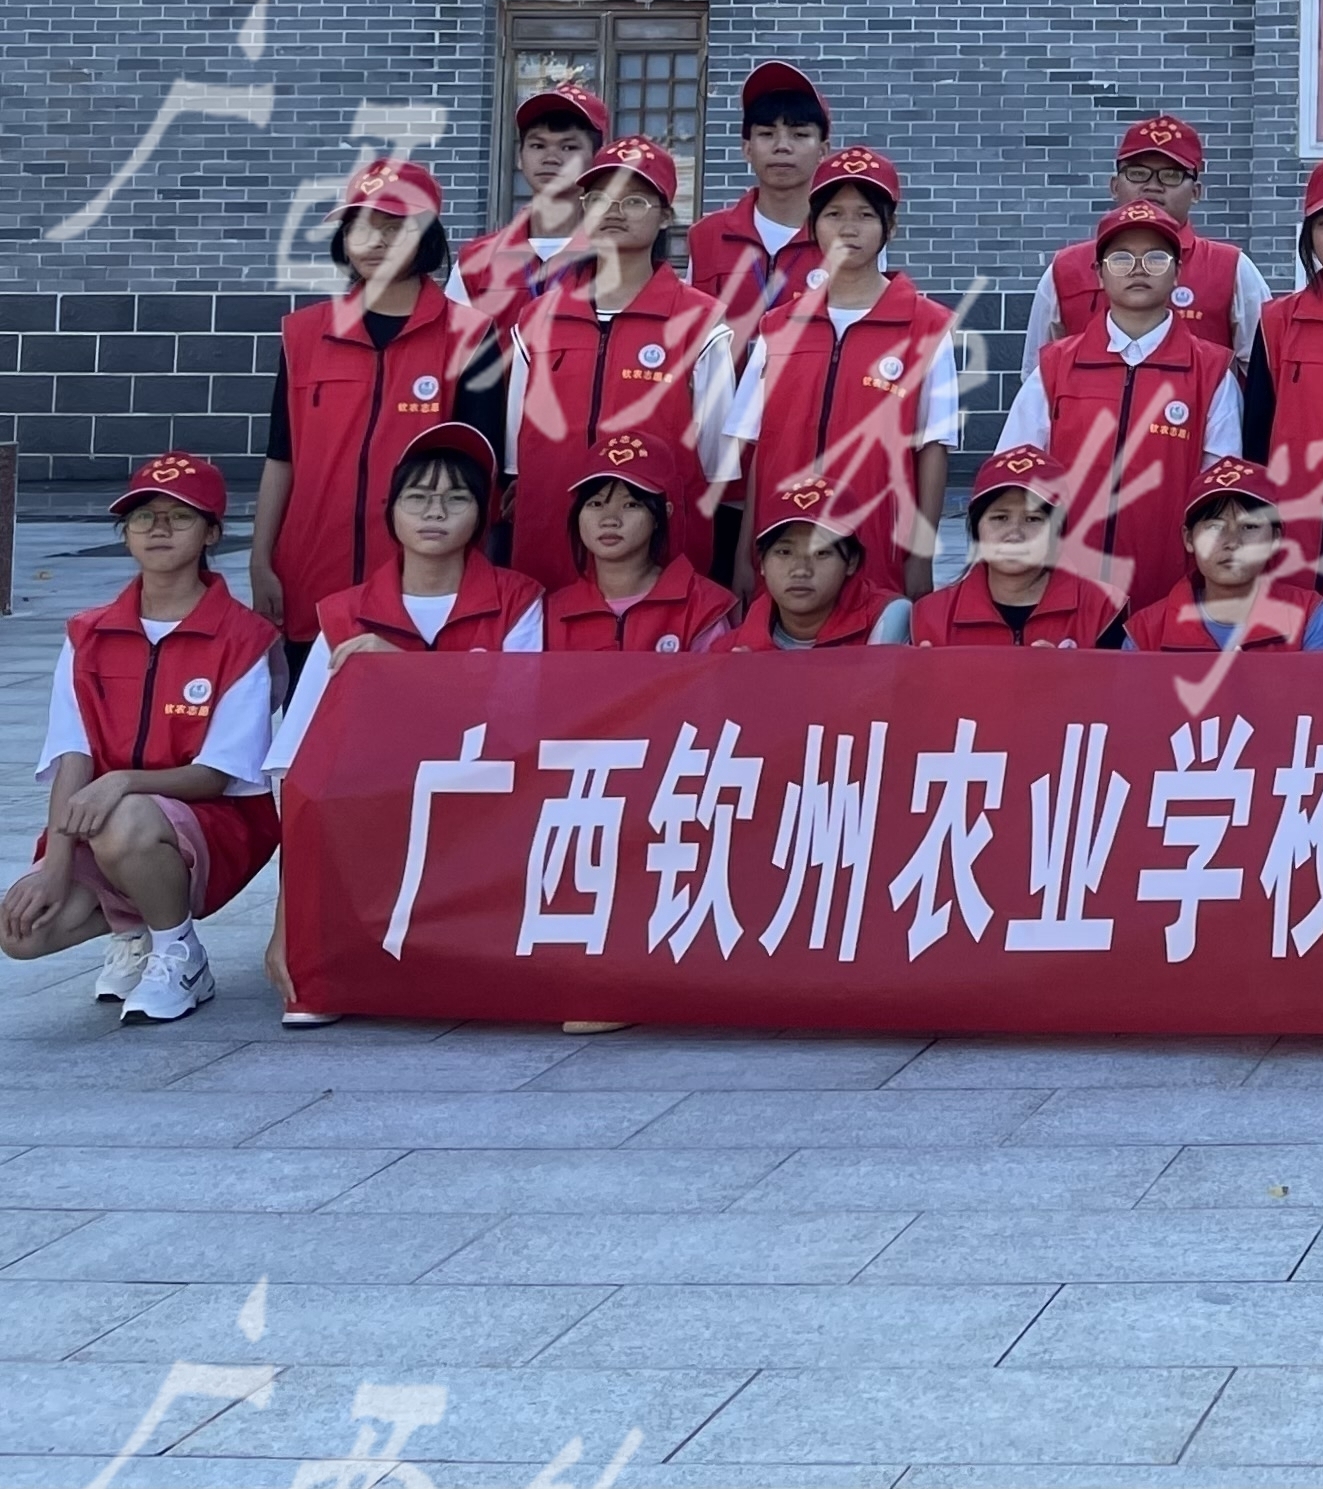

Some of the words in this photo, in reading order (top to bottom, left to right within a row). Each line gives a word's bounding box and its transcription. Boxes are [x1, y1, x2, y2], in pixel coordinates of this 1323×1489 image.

[397, 401, 440, 413] 钦农志愿
[164, 703, 210, 717] 钦农志愿
